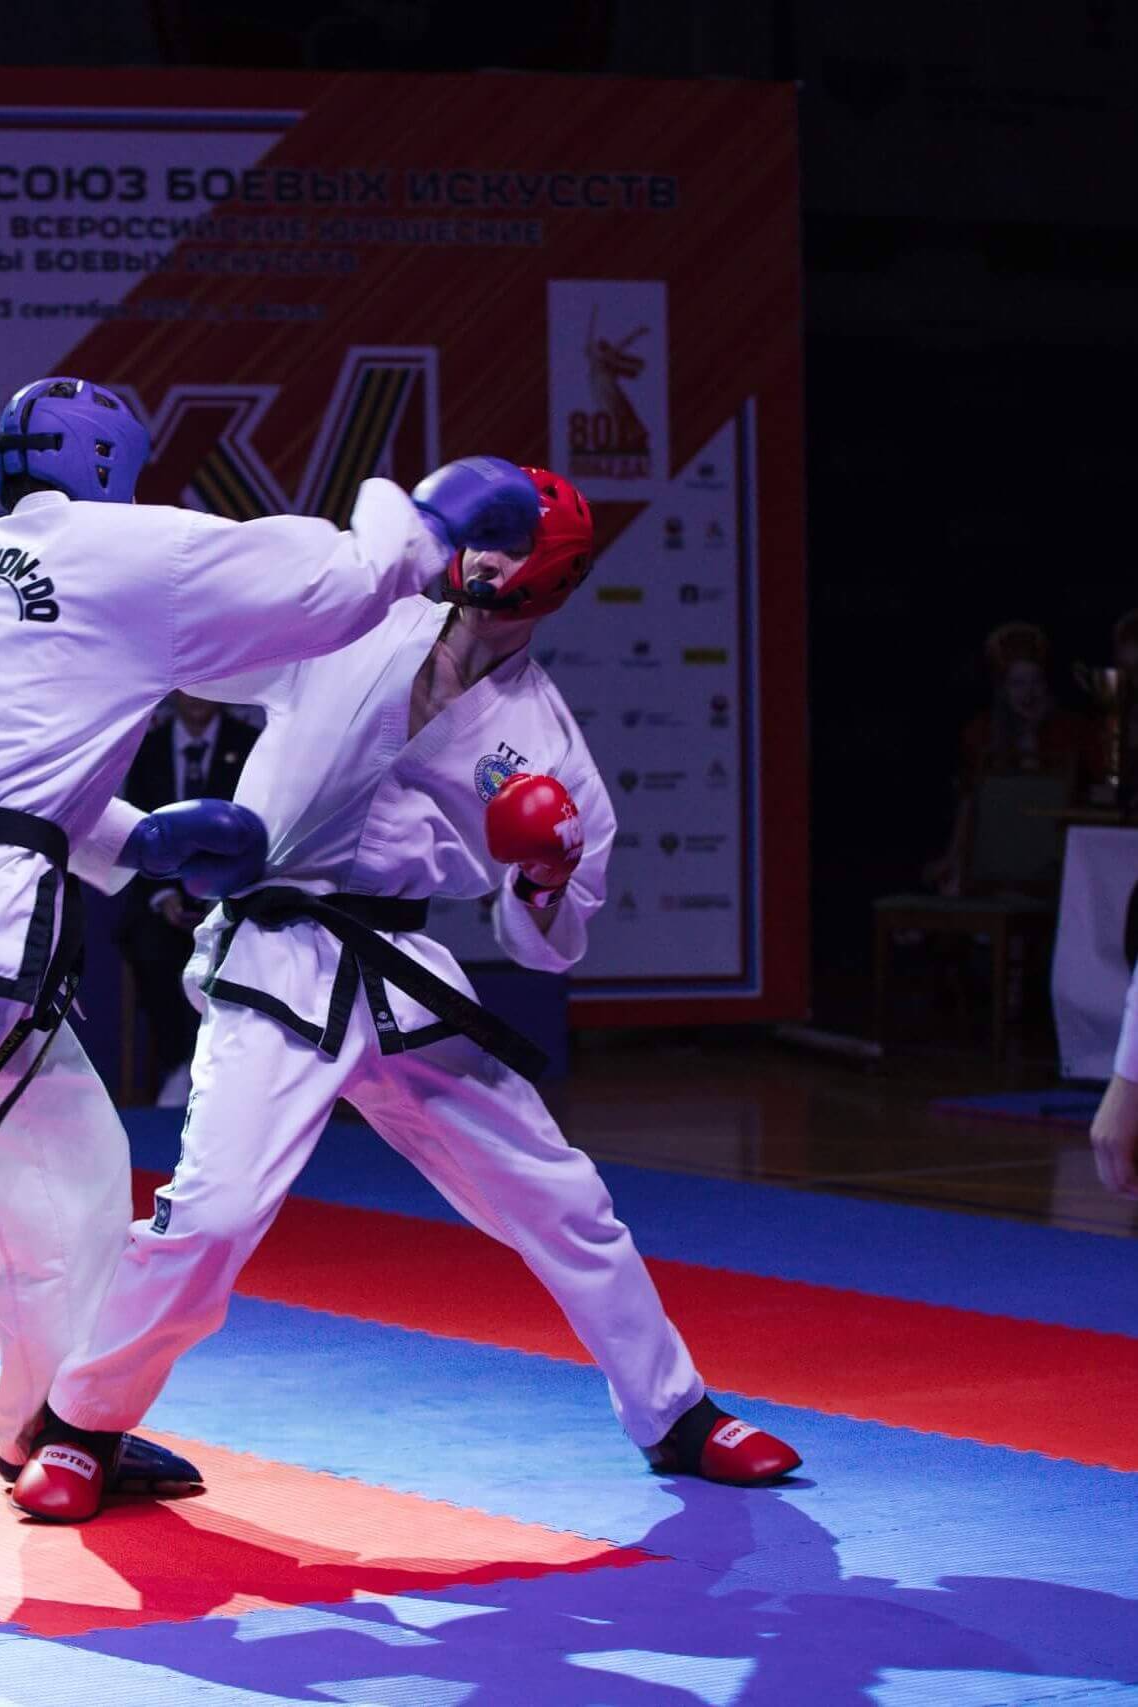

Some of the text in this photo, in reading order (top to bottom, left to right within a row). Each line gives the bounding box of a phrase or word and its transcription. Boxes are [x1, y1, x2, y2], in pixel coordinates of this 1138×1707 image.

[167, 168, 388, 204] БОЕВЫХ
[408, 172, 678, 208] ИСКУССТВ
[10, 213, 305, 241] ВСЕРОССИЙСКИЕ
[318, 219, 543, 245] ЮНОШЕСКИЕ
[34, 249, 174, 273] БОЕВЫХ
[186, 250, 357, 275] ИСКУССТВ
[497, 741, 528, 766] ITF
